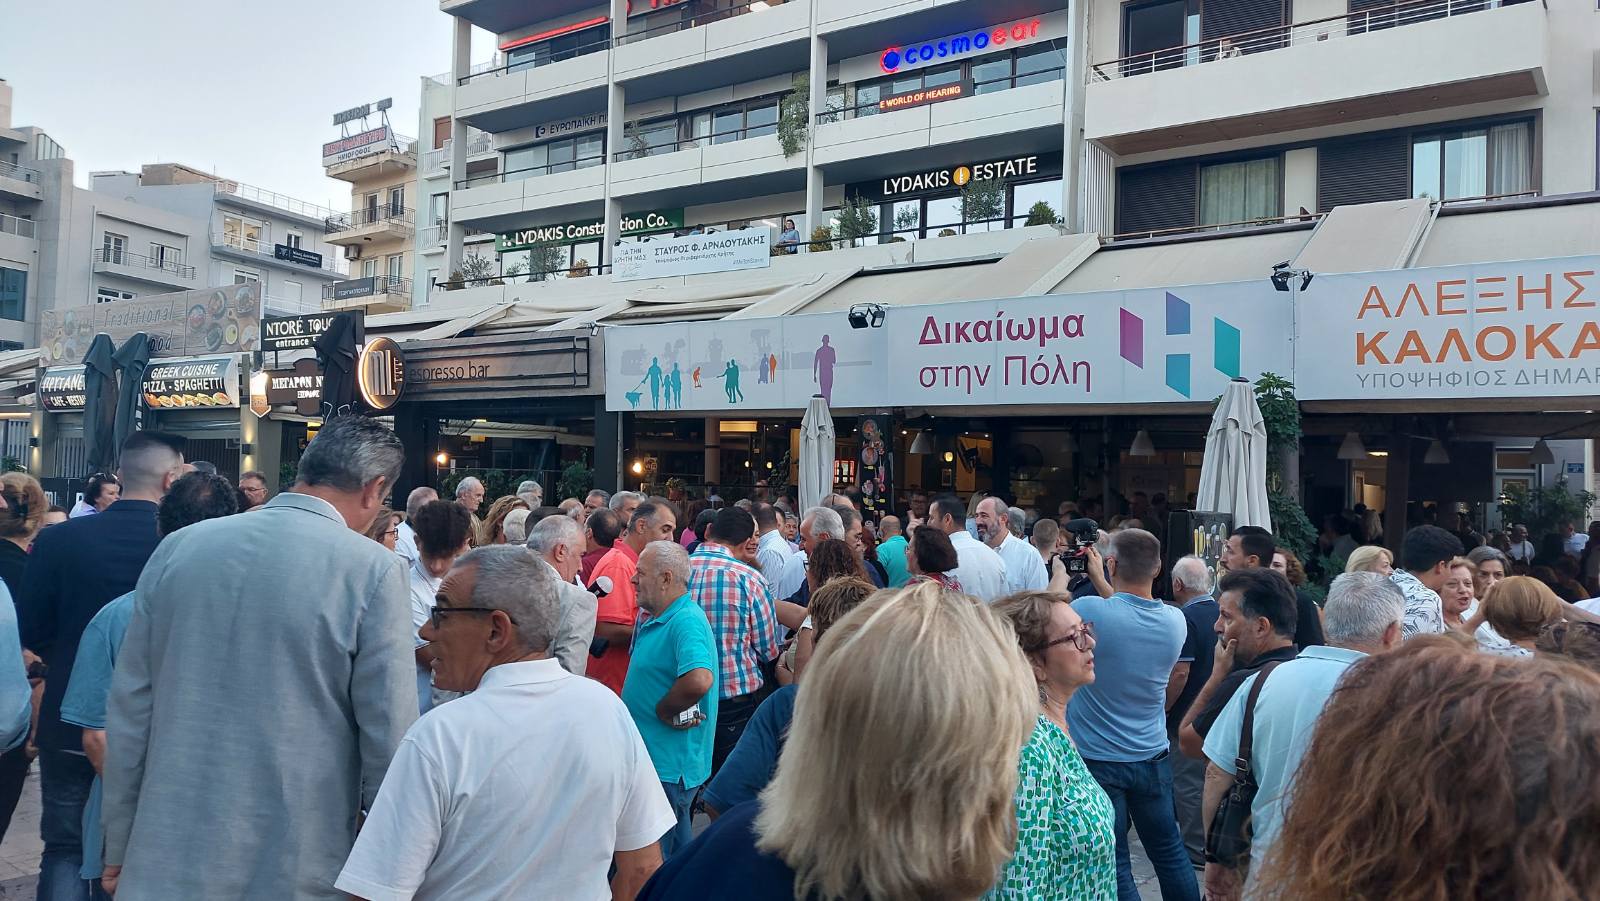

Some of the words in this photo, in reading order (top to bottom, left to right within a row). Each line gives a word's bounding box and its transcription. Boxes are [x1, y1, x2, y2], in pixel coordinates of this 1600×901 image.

[904, 18, 1041, 64] cosmoear
[886, 95, 913, 107] WORLD
[913, 92, 925, 101] OF
[926, 85, 961, 99] HEARING
[599, 114, 608, 124] ΠΙ
[883, 170, 950, 195] LYDAKIS
[973, 156, 1037, 181] ESTATE
[514, 225, 563, 246] LYDAKIS
[567, 217, 643, 239] Constrtion
[647, 213, 669, 228] Co.
[630, 247, 642, 255] ΤΗΝ
[654, 244, 689, 256] ΣΤΑΥΡΟΣ
[691, 243, 700, 252] Φ.
[702, 235, 765, 251] ΑΡΝΑΟΥΤΑΚΗΣ
[1356, 270, 1596, 319] ΑΛΕΞΗΣ
[103, 299, 174, 328] Traditional
[266, 316, 304, 337] NTORÉ
[918, 311, 1085, 348] Δικαίωμα
[149, 329, 174, 352] ood
[275, 338, 309, 348] entrance
[1356, 321, 1600, 365] ΚΑΛΟΚΑ
[150, 366, 181, 379] GREEK
[181, 363, 220, 377] CUISINE
[411, 364, 464, 382] espresso
[468, 361, 490, 379] bar
[918, 364, 992, 395] στην
[1004, 354, 1092, 393] Πόλη
[1356, 369, 1508, 389] ΥΠΟΨΗΦΙΟΣ
[142, 381, 167, 393] PIZZA
[174, 378, 223, 392] SPAGHETTI
[271, 376, 312, 389] ΜΕΓΑΡΟΝ
[50, 396, 66, 407] CAFE
